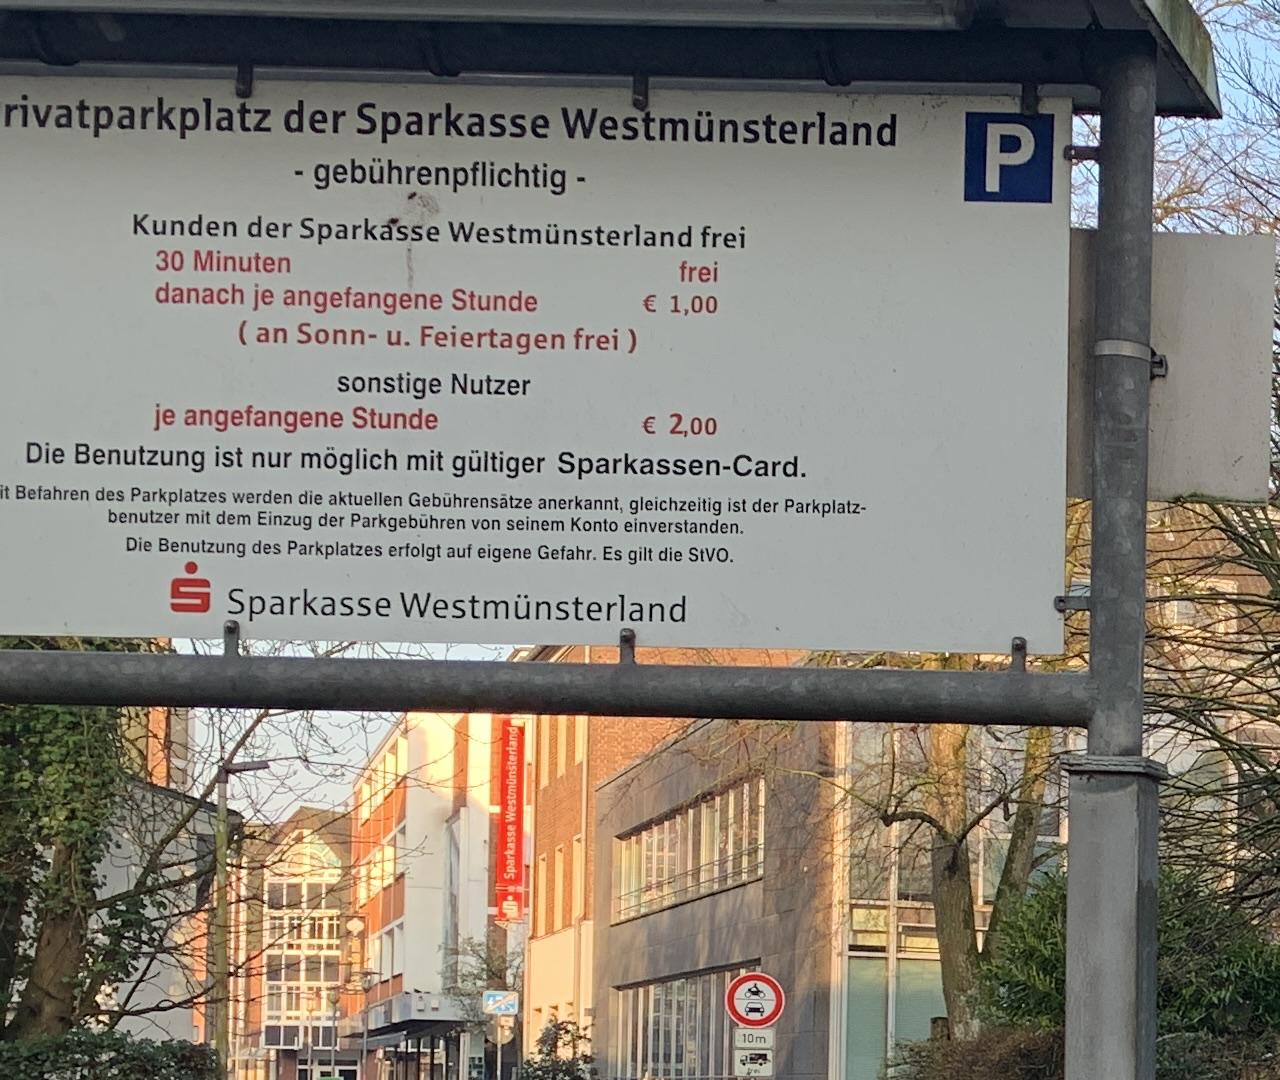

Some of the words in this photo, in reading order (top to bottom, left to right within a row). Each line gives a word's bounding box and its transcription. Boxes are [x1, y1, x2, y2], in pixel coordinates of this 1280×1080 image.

[5, 95, 271, 139] rivatparkplatz
[284, 100, 346, 134] der
[357, 103, 549, 144] Sparkasse
[561, 107, 896, 147] Westmünsterland
[985, 122, 1035, 193] P
[314, 158, 566, 194] gebührenpflichtig
[133, 214, 237, 237] Kunden
[248, 216, 292, 238] der
[300, 217, 440, 245] Sparkasse
[448, 221, 692, 247] Westmünsterland
[701, 226, 745, 248] frei
[156, 250, 184, 271] 30
[194, 250, 290, 273] Minuten
[679, 260, 718, 283] frei
[155, 282, 244, 305] danach
[253, 283, 274, 311] je
[283, 287, 443, 315] angefangene
[452, 289, 537, 312] Stunde
[643, 295, 656, 312] €
[671, 295, 718, 316] 1,00
[256, 327, 287, 344] an
[297, 323, 377, 345] Sonn-
[387, 330, 410, 346] u.
[421, 325, 565, 355] Feiertagen
[573, 328, 618, 351] frei
[337, 371, 442, 400] sonstige
[451, 373, 531, 396] Nutzer
[154, 403, 176, 431] je
[184, 405, 344, 433] angefangene
[352, 406, 438, 430] Stunde
[642, 416, 656, 434] €
[669, 413, 717, 437] 2,00
[26, 442, 65, 464] Die
[75, 443, 205, 473] Benutzung
[215, 445, 243, 468] ist
[252, 452, 292, 468] nur
[301, 447, 397, 475] möglich
[407, 450, 444, 471] mit
[452, 450, 545, 479] gültiger
[558, 452, 806, 480] Sparkassen-Card.
[0, 485, 10, 500] it
[16, 485, 89, 501] Befahren
[95, 487, 125, 502] des
[131, 487, 226, 506] Parkplatzes
[232, 490, 292, 504] werden
[299, 490, 323, 505] die
[328, 491, 402, 507] aktuellen
[408, 492, 532, 509] Gebührensätze
[538, 496, 623, 513] anerkannt,
[629, 496, 721, 516] gleichzeitig
[728, 497, 746, 512] ist
[752, 498, 779, 513] der
[784, 499, 866, 518] Parkplatz-
[108, 509, 180, 524] benutzer
[186, 510, 211, 524] mit
[216, 510, 251, 525] dem
[258, 511, 312, 531] Einzug
[318, 513, 345, 527] der
[351, 513, 466, 533] Parkgebühren
[471, 519, 500, 530] von
[506, 516, 564, 531] seinem
[571, 517, 618, 532] Konto
[624, 518, 744, 534] einverstanden.
[126, 537, 152, 552] Die
[159, 538, 246, 558] Benutzung
[252, 540, 281, 555] des
[288, 540, 382, 560] Parkplatzes
[388, 543, 441, 561] erfolgt
[447, 544, 472, 558] auf
[477, 544, 531, 563] eigene
[538, 545, 596, 560] Gefahr.
[603, 546, 622, 561] Es
[628, 547, 653, 565] gilt
[659, 547, 682, 562] die
[688, 547, 733, 563] StVO.
[227, 588, 391, 622] Sparkasse
[400, 592, 686, 622] Westmünsterland
[504, 824, 518, 880] Sparkasse
